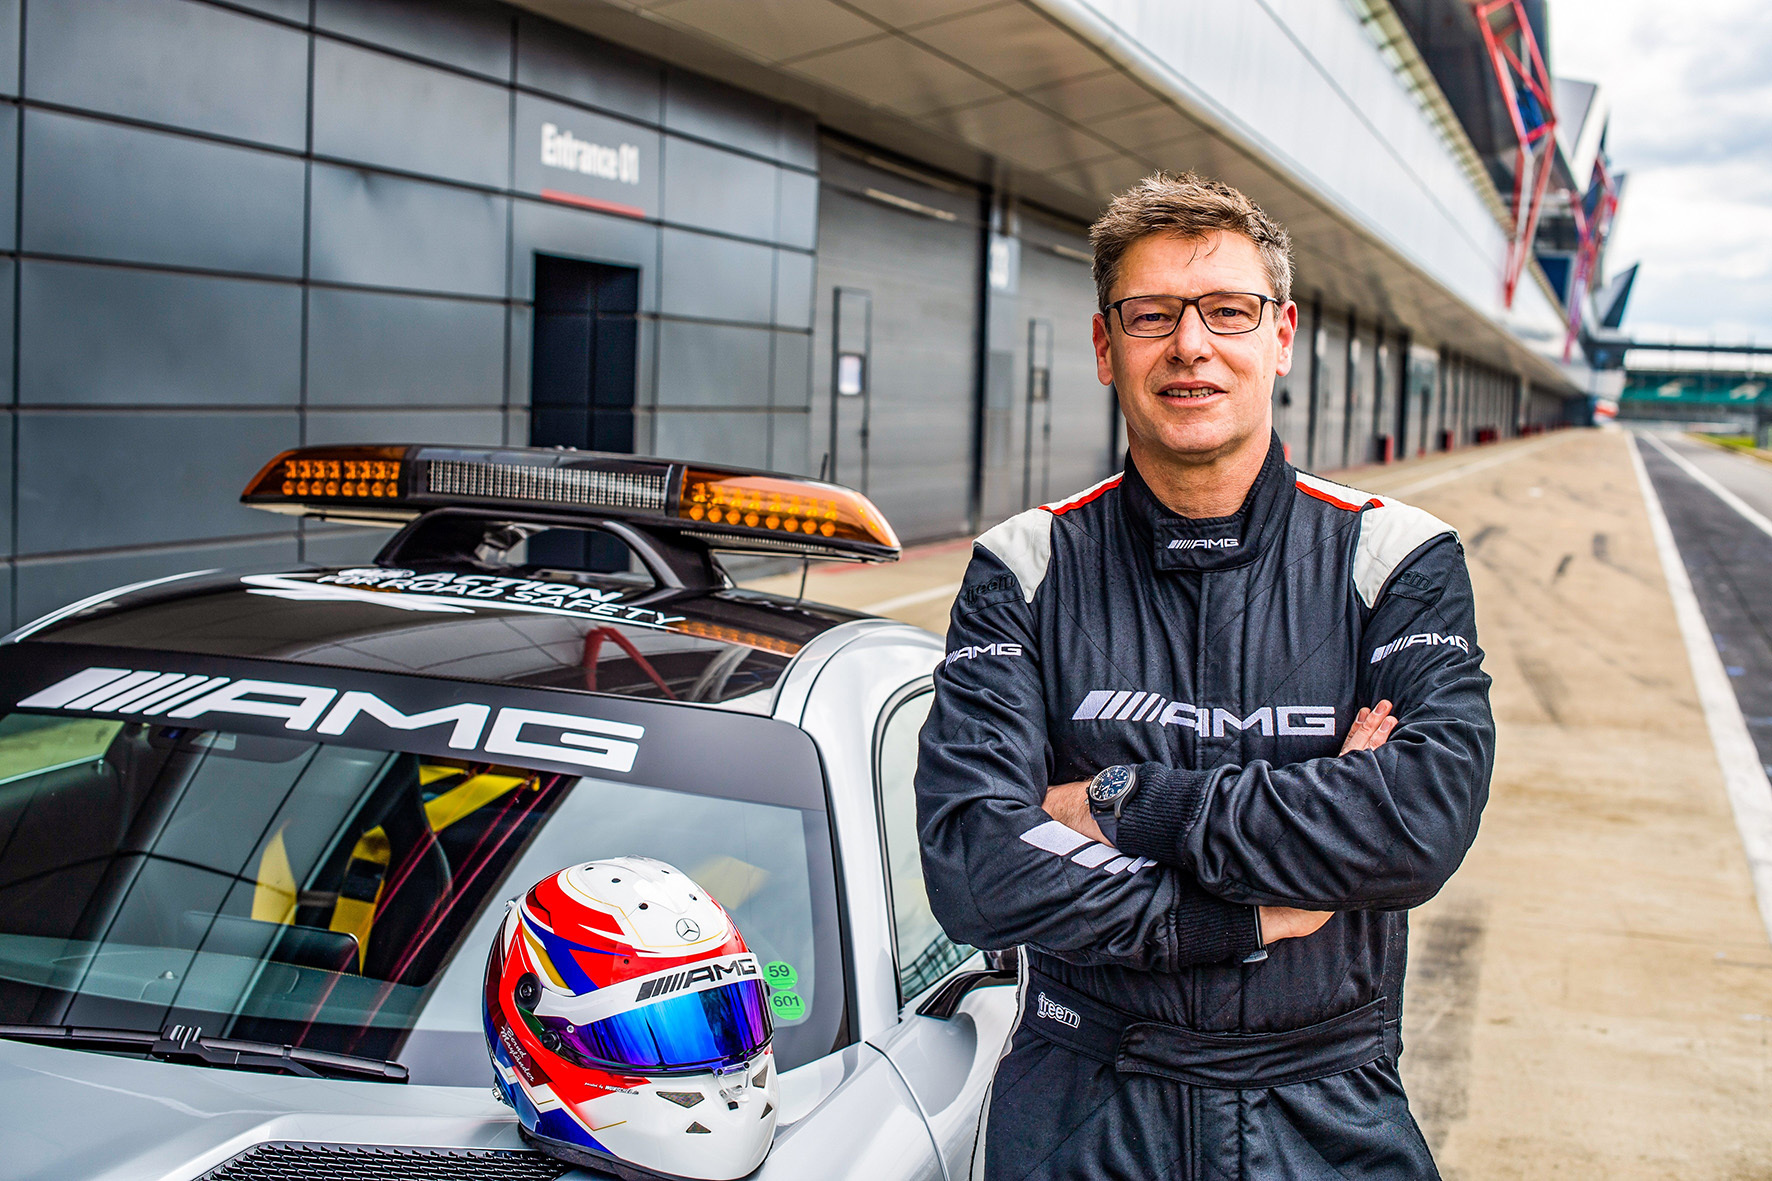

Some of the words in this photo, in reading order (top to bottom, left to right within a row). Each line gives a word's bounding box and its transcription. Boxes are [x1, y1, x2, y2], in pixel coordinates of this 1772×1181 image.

[541, 122, 618, 180] Entrance
[1190, 538, 1240, 550] AMG
[377, 578, 504, 598] ROAD
[505, 591, 687, 625] SAFETY
[411, 571, 624, 603] ACTION
[953, 642, 1023, 662] AMG
[1403, 632, 1469, 655] AMG
[167, 678, 646, 773] AMG
[1159, 701, 1336, 738] AMG
[682, 958, 758, 989] AMG
[768, 964, 791, 979] 59
[773, 995, 801, 1008] 601
[1037, 992, 1080, 1028] freem
